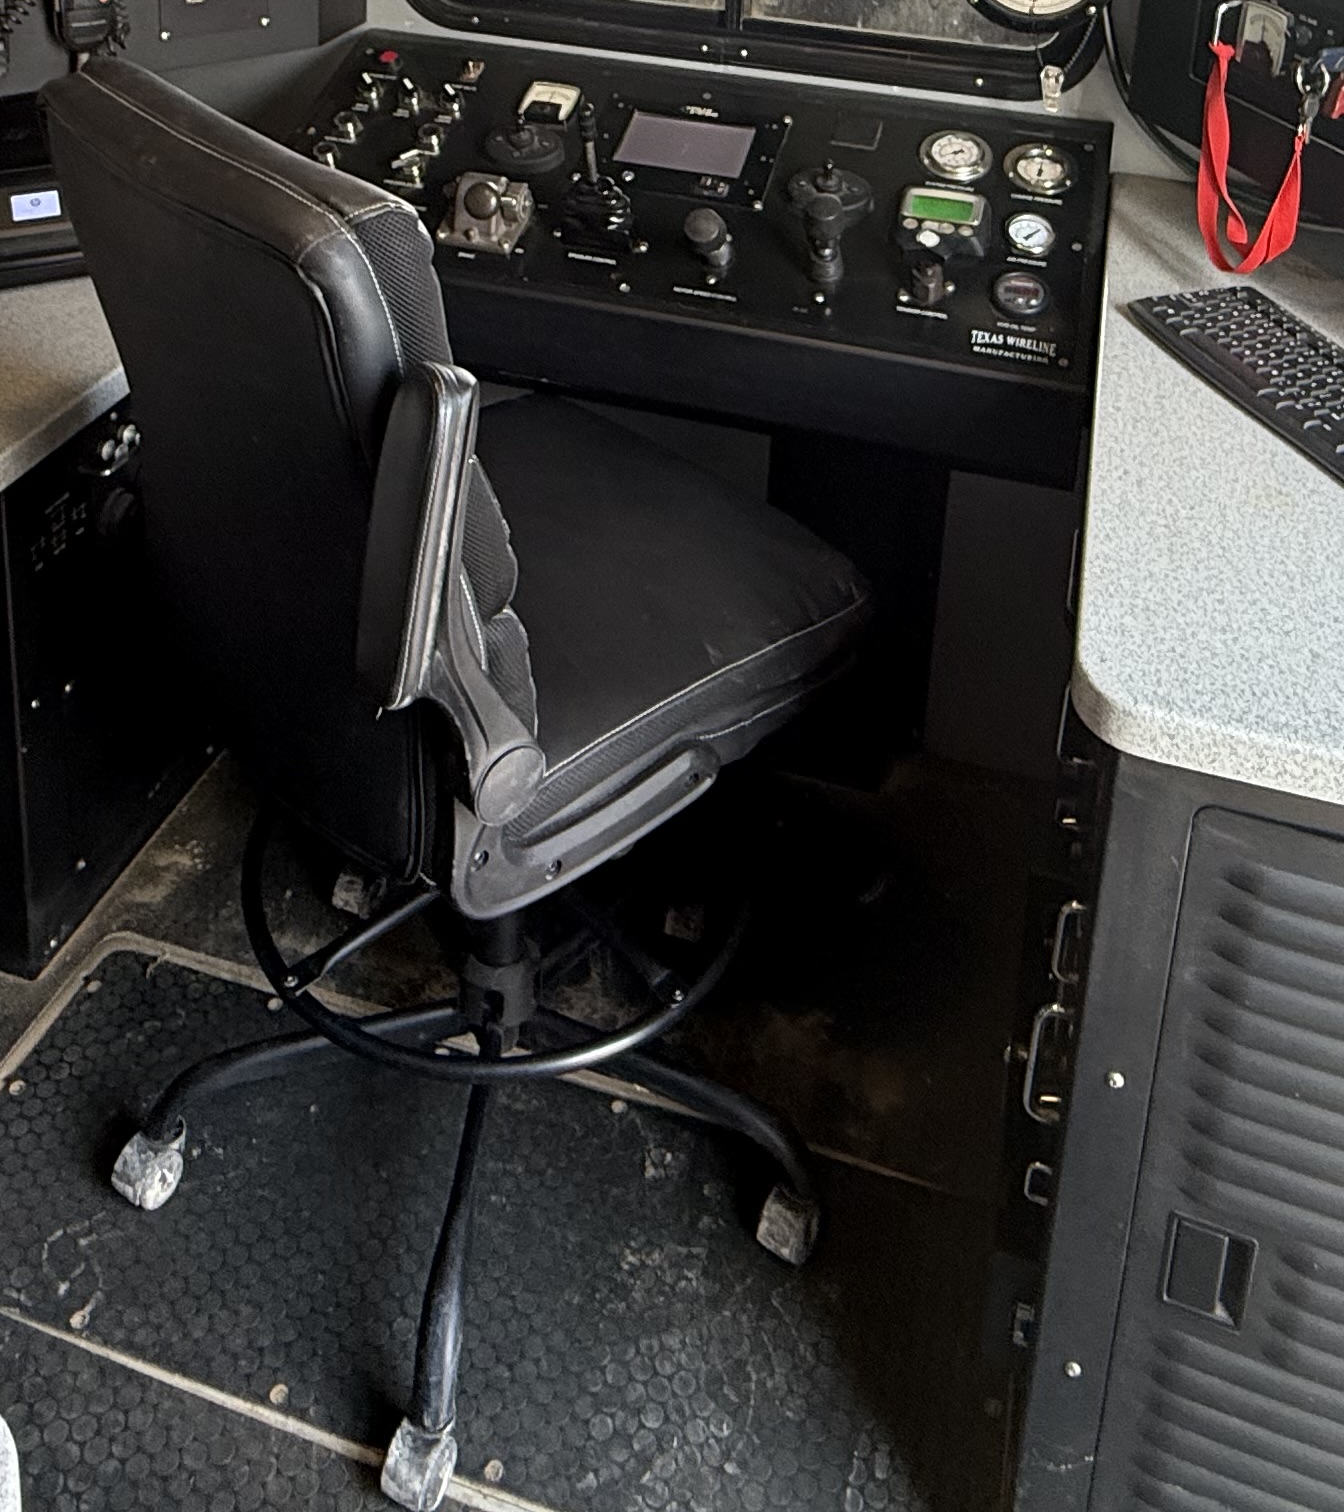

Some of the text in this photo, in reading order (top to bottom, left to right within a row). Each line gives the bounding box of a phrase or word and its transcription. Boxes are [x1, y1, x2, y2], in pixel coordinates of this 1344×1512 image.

[971, 329, 1057, 357] TEXAS WIRELINE
[973, 345, 1049, 365] MANUFACTURING
